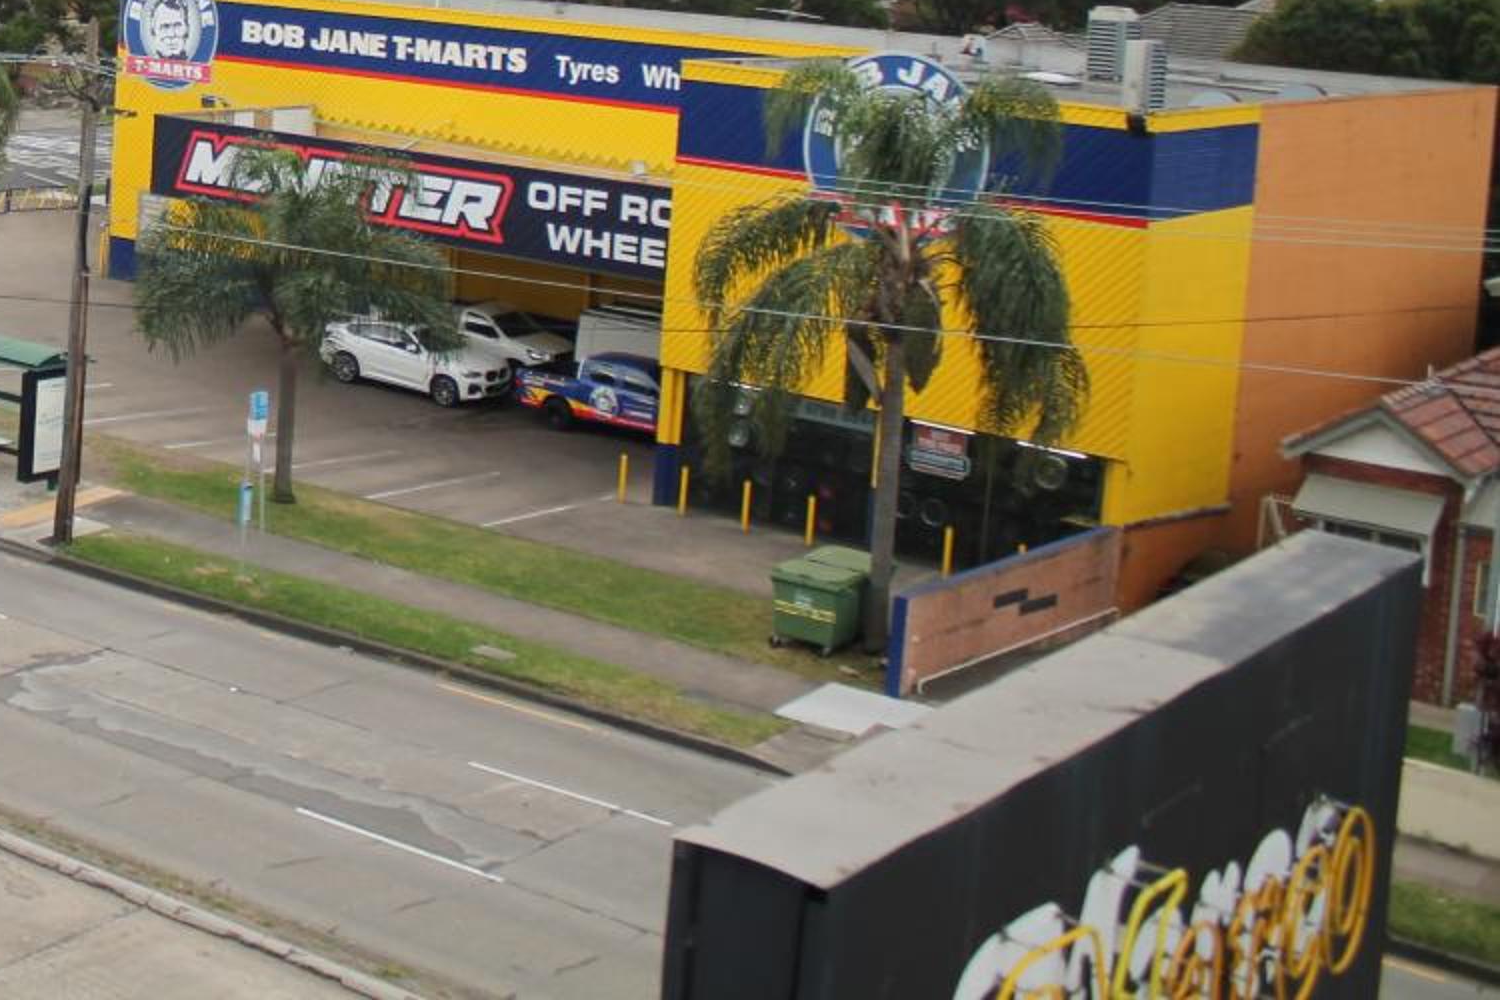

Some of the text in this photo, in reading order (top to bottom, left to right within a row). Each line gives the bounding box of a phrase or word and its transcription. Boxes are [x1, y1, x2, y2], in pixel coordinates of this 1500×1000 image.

[134, 59, 203, 80] T-MARTS
[241, 19, 304, 50] BOB
[310, 27, 387, 58] JANE
[393, 35, 528, 74] T-MARTS
[555, 55, 619, 84] Tyres
[527, 180, 609, 217] OFF
[546, 222, 666, 269] WHEE
